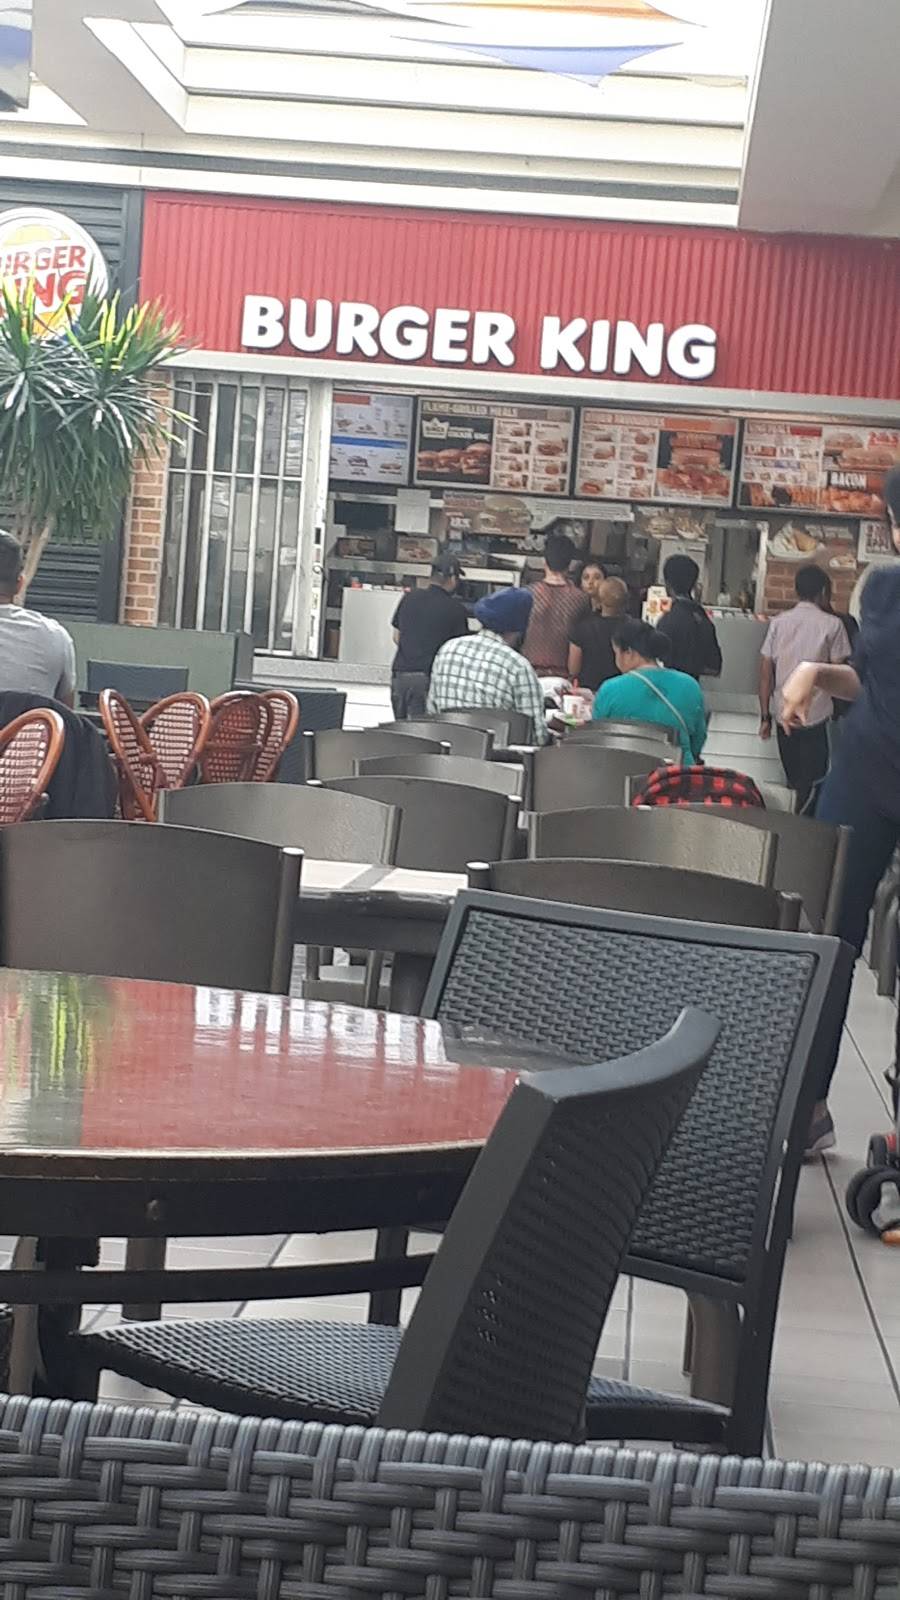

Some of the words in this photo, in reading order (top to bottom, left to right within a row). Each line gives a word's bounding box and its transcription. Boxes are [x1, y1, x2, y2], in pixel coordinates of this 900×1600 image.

[0, 246, 86, 277] URGER
[241, 295, 515, 367] BURGER
[540, 316, 717, 379] KING
[830, 471, 867, 489] BACON
